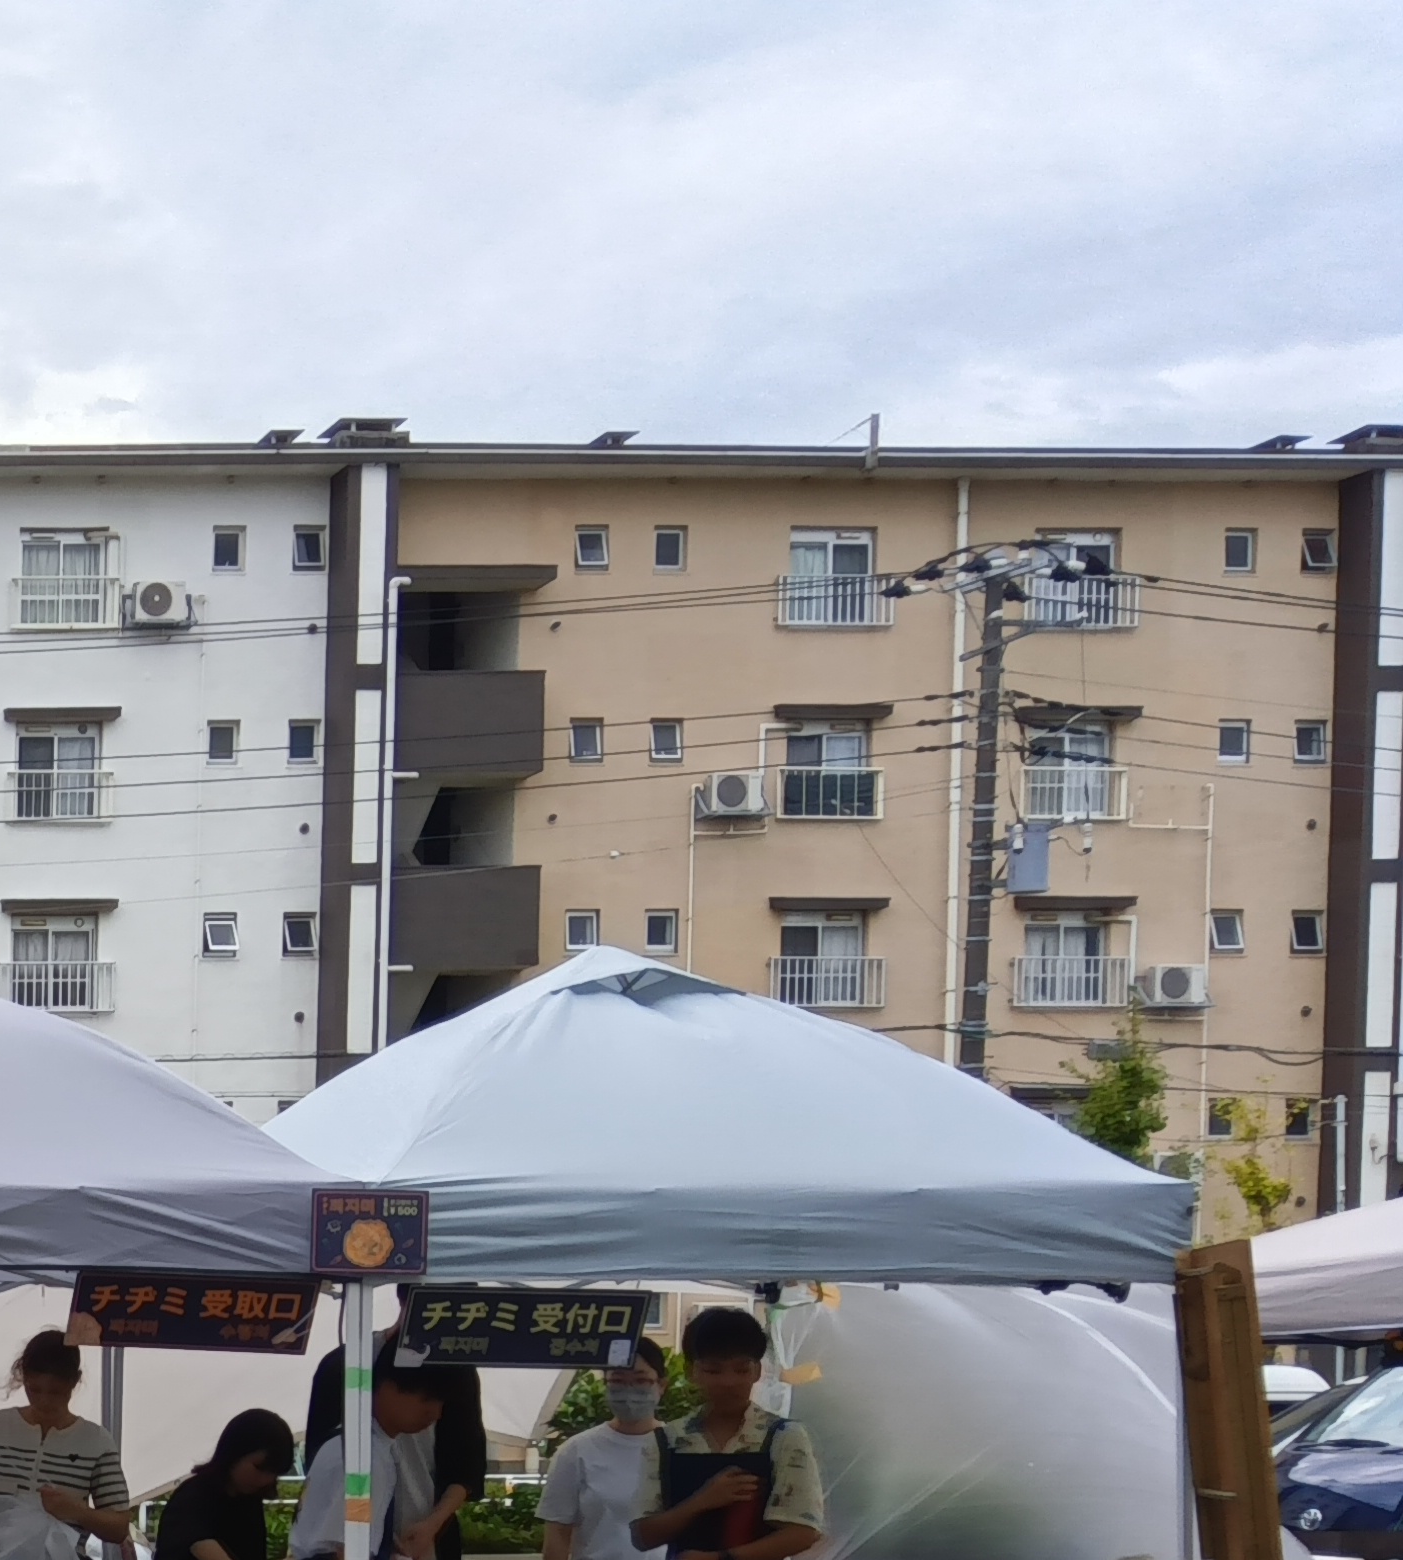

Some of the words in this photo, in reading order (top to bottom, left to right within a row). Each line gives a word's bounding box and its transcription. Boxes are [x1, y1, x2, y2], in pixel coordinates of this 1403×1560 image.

[89, 1284, 188, 1316] チヂミ
[199, 1288, 303, 1322] 受取口
[421, 1300, 520, 1331] チヂミ
[530, 1302, 633, 1334] 受付口
